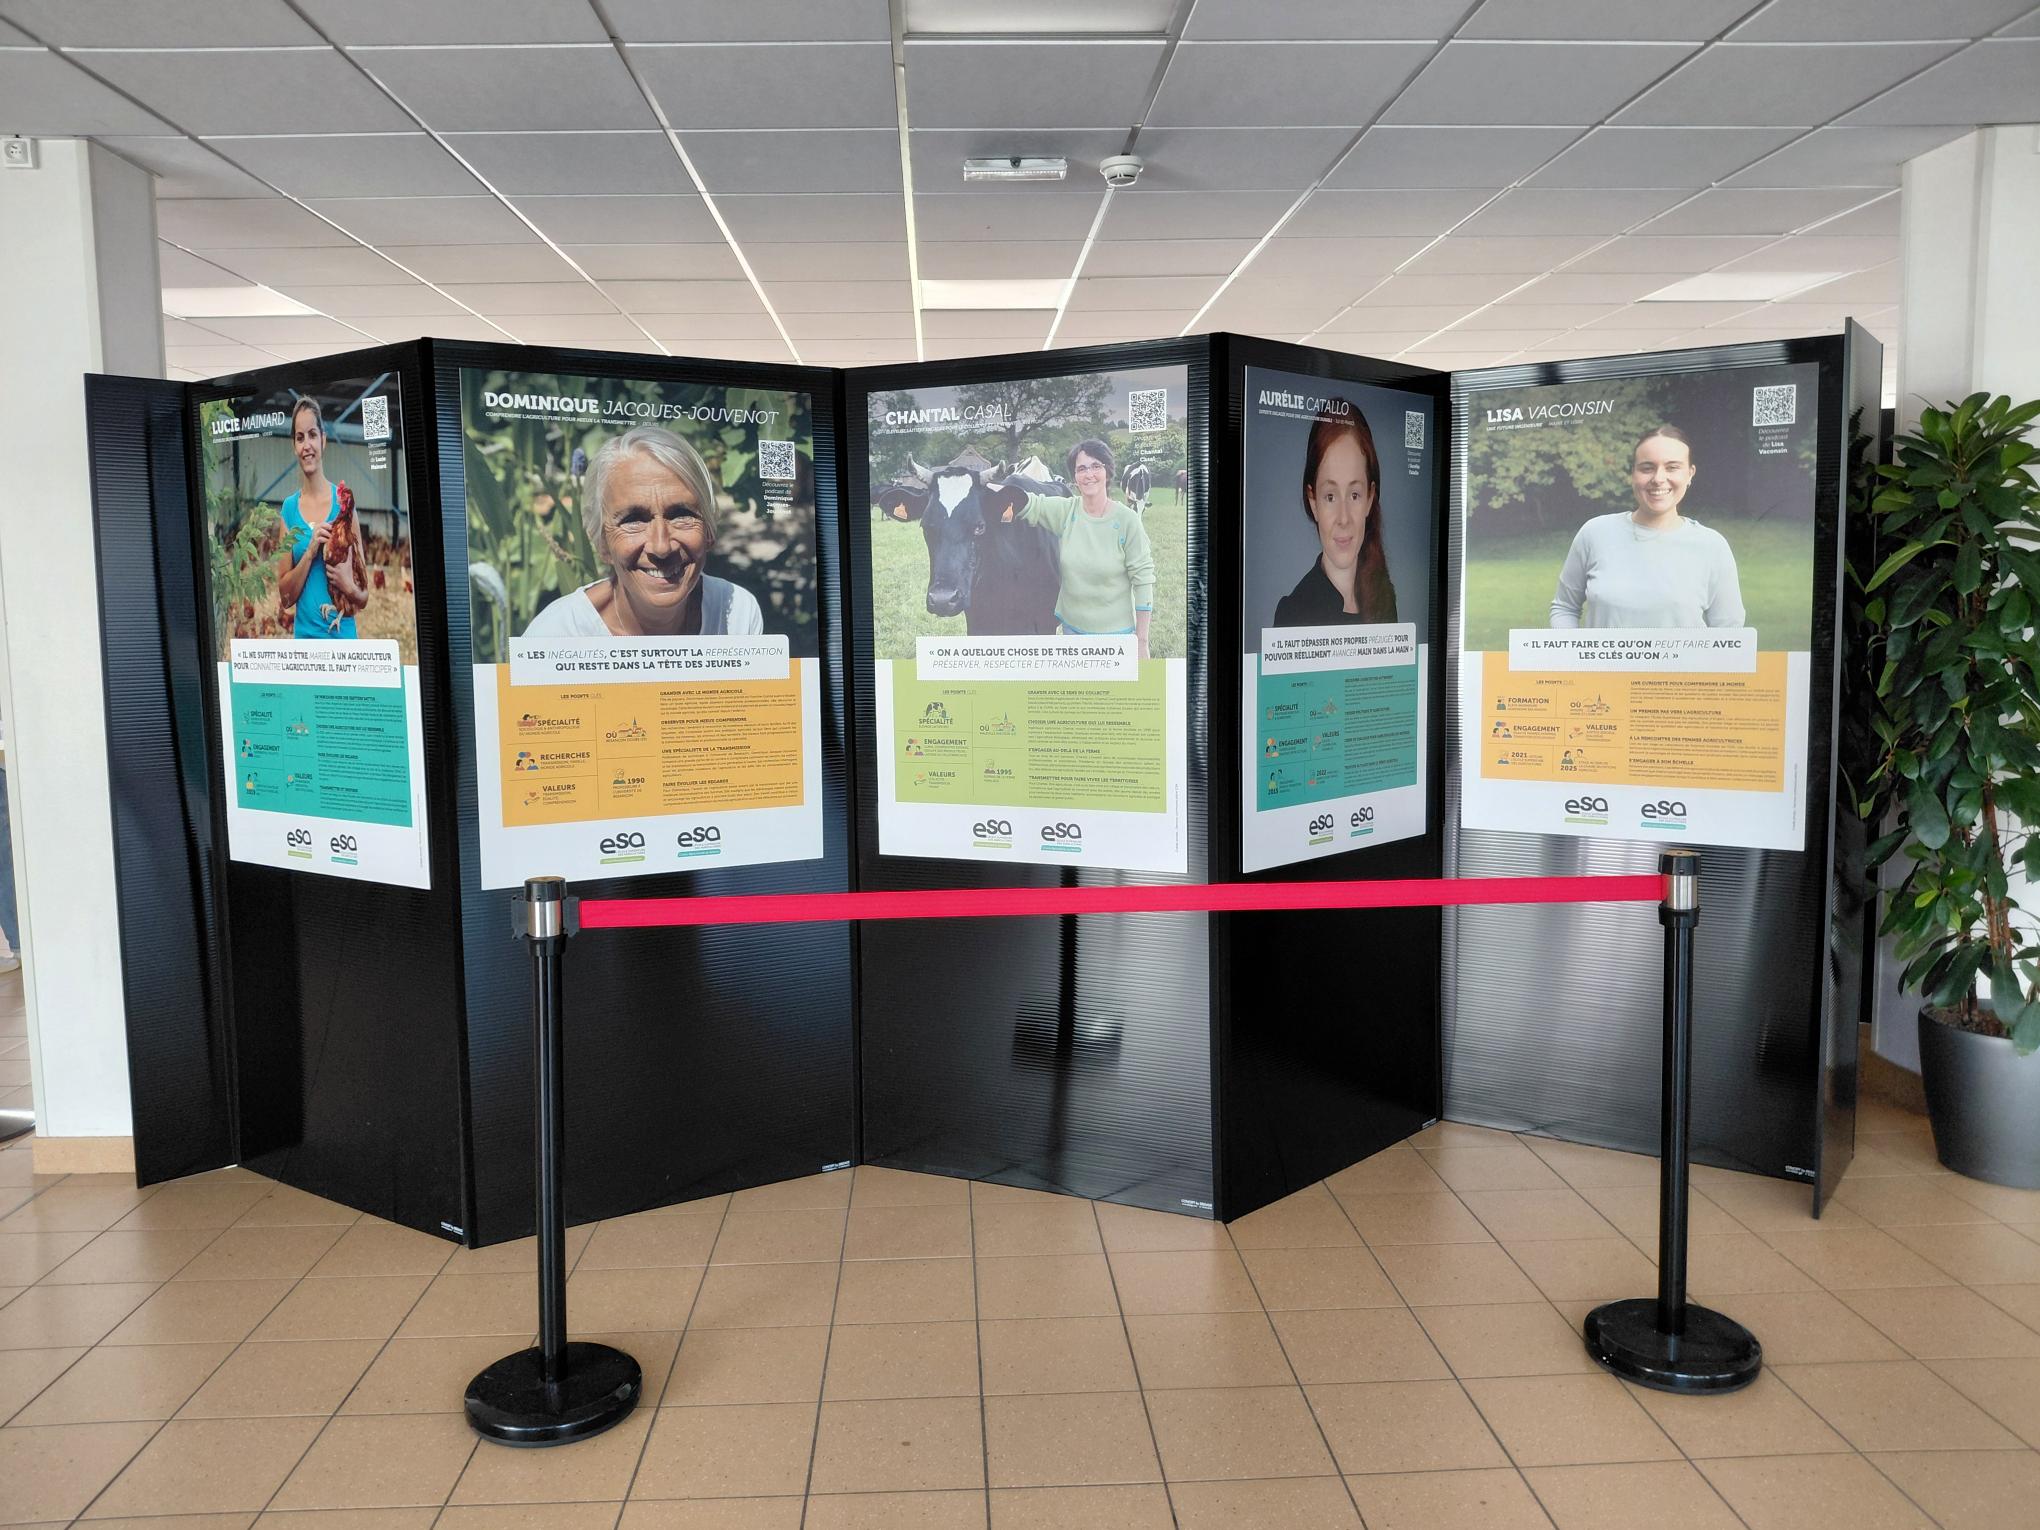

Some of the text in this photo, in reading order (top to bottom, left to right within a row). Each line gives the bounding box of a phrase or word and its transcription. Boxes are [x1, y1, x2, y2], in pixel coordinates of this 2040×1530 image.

[484, 392, 779, 425] DOMINIQUE JACQUES-JOUVENOT
[1259, 389, 1349, 416] AURÉLIE CATALLO
[1487, 400, 1614, 423] LISA VACONSIN
[212, 411, 285, 434] LUCIE MAINARD
[885, 403, 1012, 425] CHANTAL CASAL
[1277, 640, 1283, 648] IL
[1285, 640, 1300, 648] FAUT
[1301, 637, 1329, 647] DÉPASSER
[1344, 636, 1368, 645] PROPRES
[1394, 634, 1408, 642] POUR
[1601, 640, 1615, 648] CE
[1618, 640, 1652, 648] QU'ON
[1654, 640, 1680, 648] PEUT
[1682, 640, 1710, 648] FAIRE
[1712, 640, 1742, 648] AVEC
[337, 652, 346, 660] UN
[348, 652, 392, 661] AGRICULTEUR
[527, 651, 545, 659] LES
[548, 649, 608, 659] INÉGALITÉS,
[610, 649, 638, 658] C'EST
[641, 649, 689, 657] SURTOUT
[691, 649, 703, 657] LA
[705, 648, 783, 656] REPRÉSENTATION
[937, 648, 951, 656] ON
[953, 648, 960, 656] A
[962, 648, 1005, 657] QUELQUE
[1007, 648, 1039, 656] CHOSE
[1041, 648, 1053, 656] DE
[1056, 646, 1079, 656] TRÈS
[1081, 648, 1115, 656] GRAND
[1118, 646, 1124, 656] À
[1265, 652, 1292, 661] POUVOIR
[1388, 646, 1394, 654] LA
[1396, 645, 1409, 653] MAIN
[1598, 650, 1622, 659] CLÉS
[1625, 652, 1660, 660] QU'ON
[234, 662, 249, 670] POUR
[329, 664, 335, 672] IL
[336, 664, 351, 672] FAUT
[352, 664, 357, 672] Y
[358, 665, 392, 673] PARTICIPER
[555, 662, 575, 671] QUI
[579, 662, 610, 670] RESTE
[613, 662, 640, 670] DANS
[643, 661, 655, 669] LA
[658, 659, 682, 669] TÊTE
[685, 660, 703, 668] DES
[705, 660, 742, 668] JEUNES
[984, 660, 1032, 668] RESPECTER
[1034, 660, 1044, 668] ET
[1048, 660, 1111, 668] TRANSMETTRE
[537, 718, 580, 726] SPÉCIALITÉ
[919, 717, 953, 725] SPÉCIALITÉ
[540, 752, 590, 760] RECHERCHES
[542, 784, 576, 792] VALEURS
[1565, 796, 1608, 814] esa
[1641, 800, 1687, 819] esa
[1309, 814, 1334, 835] esa
[1351, 807, 1374, 827] esa
[677, 826, 721, 848] esa
[973, 819, 1012, 838] esa
[1041, 822, 1082, 841] esa
[287, 829, 312, 847] esa
[330, 834, 357, 853] esa
[600, 832, 646, 854] esa
